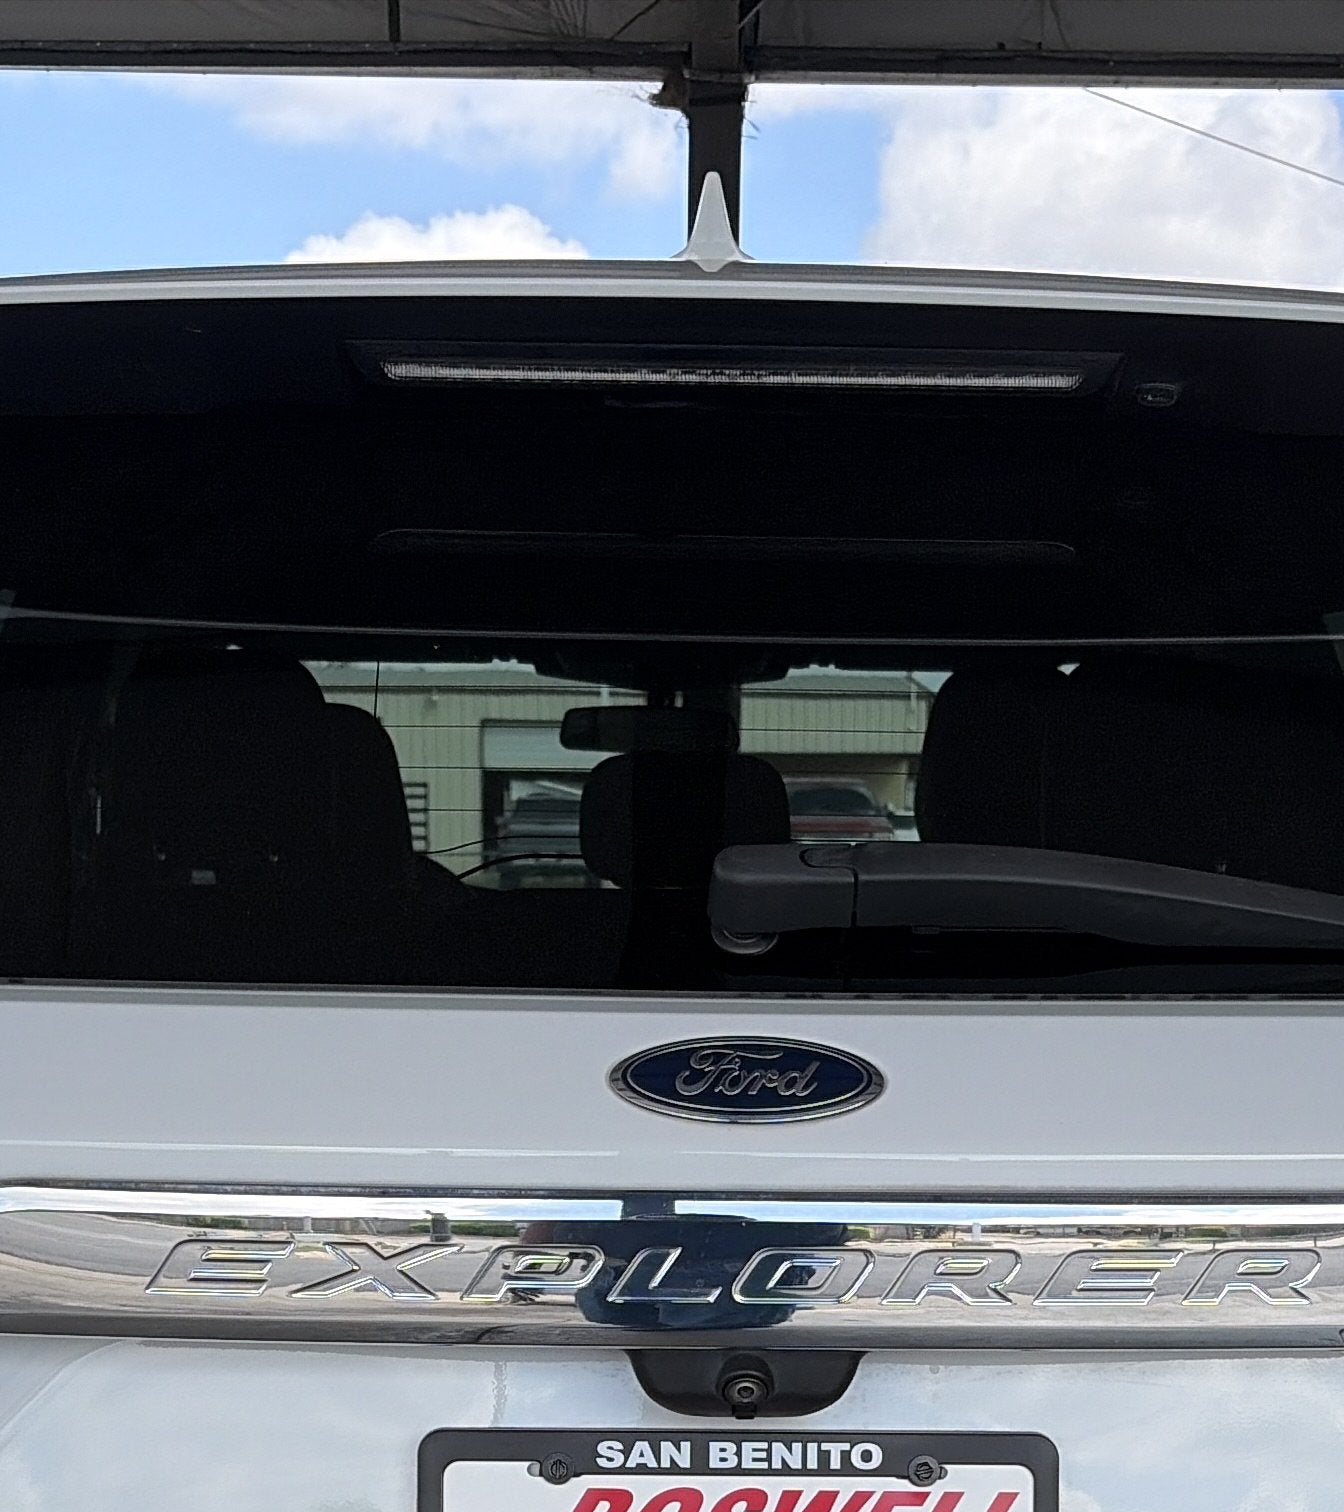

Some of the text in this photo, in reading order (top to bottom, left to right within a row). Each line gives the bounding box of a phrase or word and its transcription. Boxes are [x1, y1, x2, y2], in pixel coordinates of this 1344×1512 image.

[675, 1049, 821, 1097] Ford
[145, 1238, 1322, 1307] EXPLORER
[595, 1441, 883, 1471] SAN BENITO
